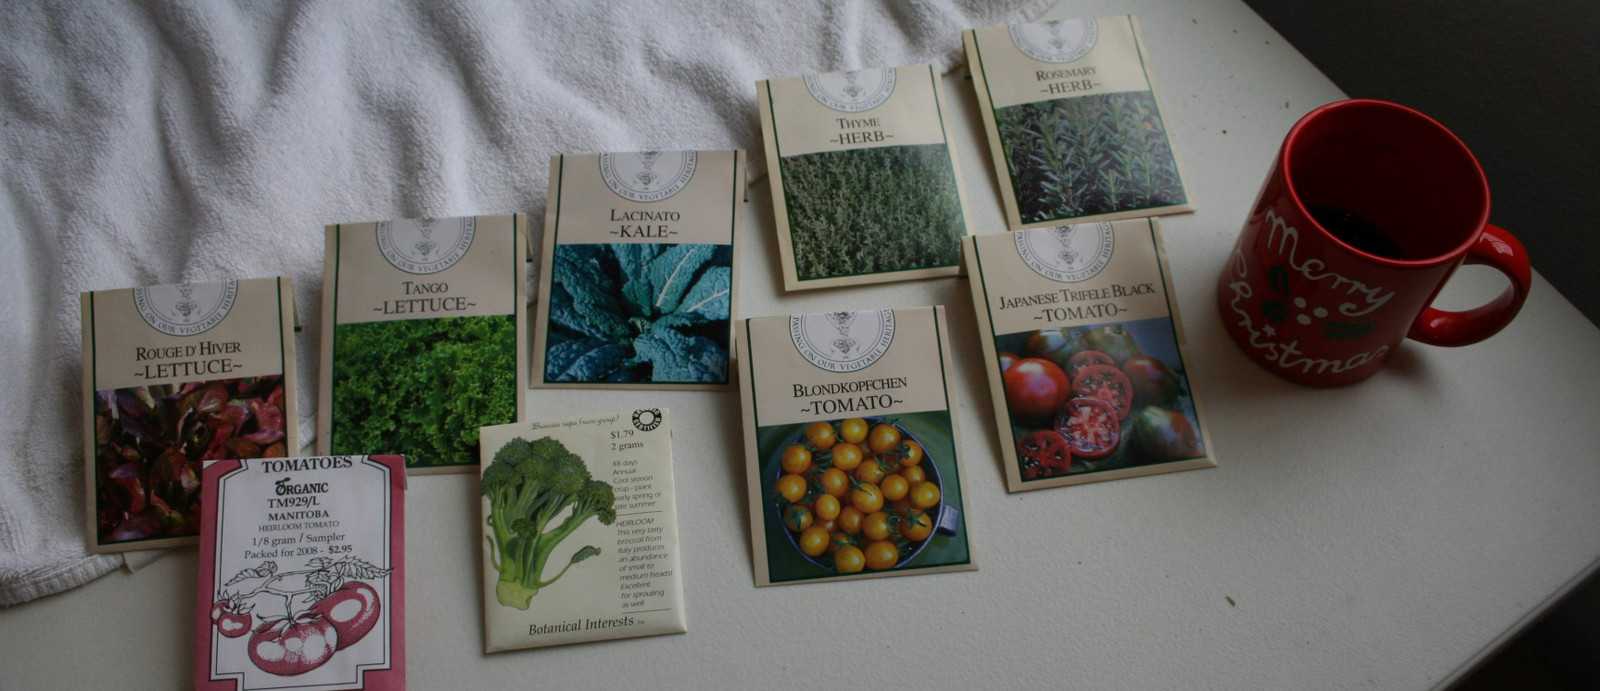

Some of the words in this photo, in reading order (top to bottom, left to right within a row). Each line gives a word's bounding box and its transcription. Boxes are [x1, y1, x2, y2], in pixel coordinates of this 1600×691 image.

[1036, 66, 1096, 82] ROSEMARY
[835, 117, 880, 130] THYME
[610, 208, 680, 222] LACINATO
[1265, 208, 1396, 317] Merry
[401, 281, 448, 295] TANGO
[1000, 291, 1059, 310] JAPANESE
[1059, 287, 1111, 303] TRIFELE
[1111, 282, 1156, 299] BLACK
[136, 345, 183, 361] ROUGE
[199, 340, 242, 356] HIVER
[792, 376, 908, 398] BLONDKOPFCHEN
[610, 430, 634, 440] $1.79
[611, 442, 617, 451] 2
[618, 441, 644, 452] grams
[262, 456, 353, 473] TOMATOES
[267, 496, 320, 508] TM929/L
[268, 509, 330, 521] MANITOBA
[258, 522, 302, 533] HEIRLOOM
[304, 520, 340, 530] TOMATO
[616, 518, 655, 528] HEIRLOOM
[251, 536, 269, 547] 1/8
[271, 537, 296, 549] gram
[306, 533, 347, 546] Sampler
[243, 548, 278, 560] Packed
[280, 547, 294, 558] for
[296, 546, 318, 557] 2008
[329, 544, 353, 555] $2.95
[528, 619, 581, 636] Botanical
[585, 616, 634, 631] Interests
